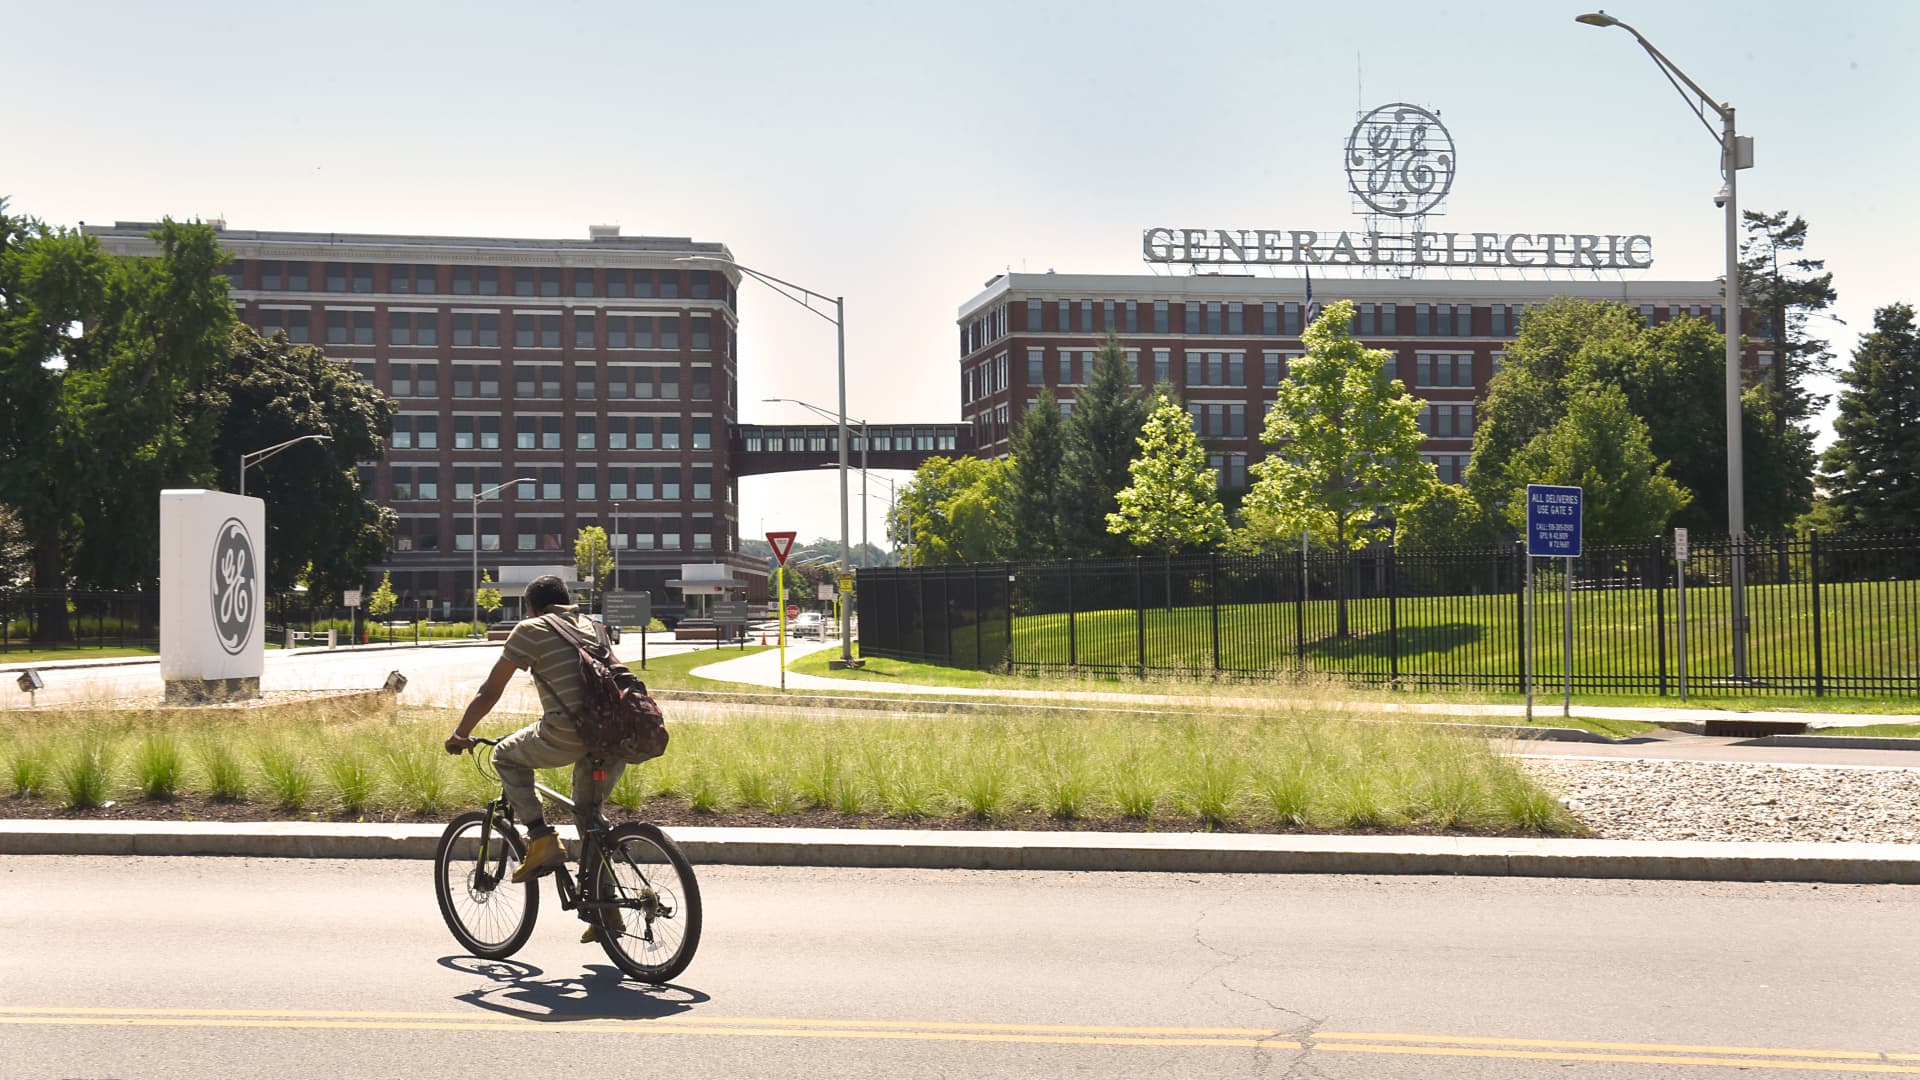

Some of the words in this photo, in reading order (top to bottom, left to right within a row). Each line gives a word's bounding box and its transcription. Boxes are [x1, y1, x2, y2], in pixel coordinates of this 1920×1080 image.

[1143, 228, 1394, 265] GENERAL
[1411, 231, 1654, 268] ELECTRIC
[1531, 493, 1544, 503] ALL
[1545, 494, 1578, 504] DELIVERIES
[1536, 505, 1549, 514] USE
[1551, 505, 1567, 515] GATE
[1568, 506, 1573, 516] 5
